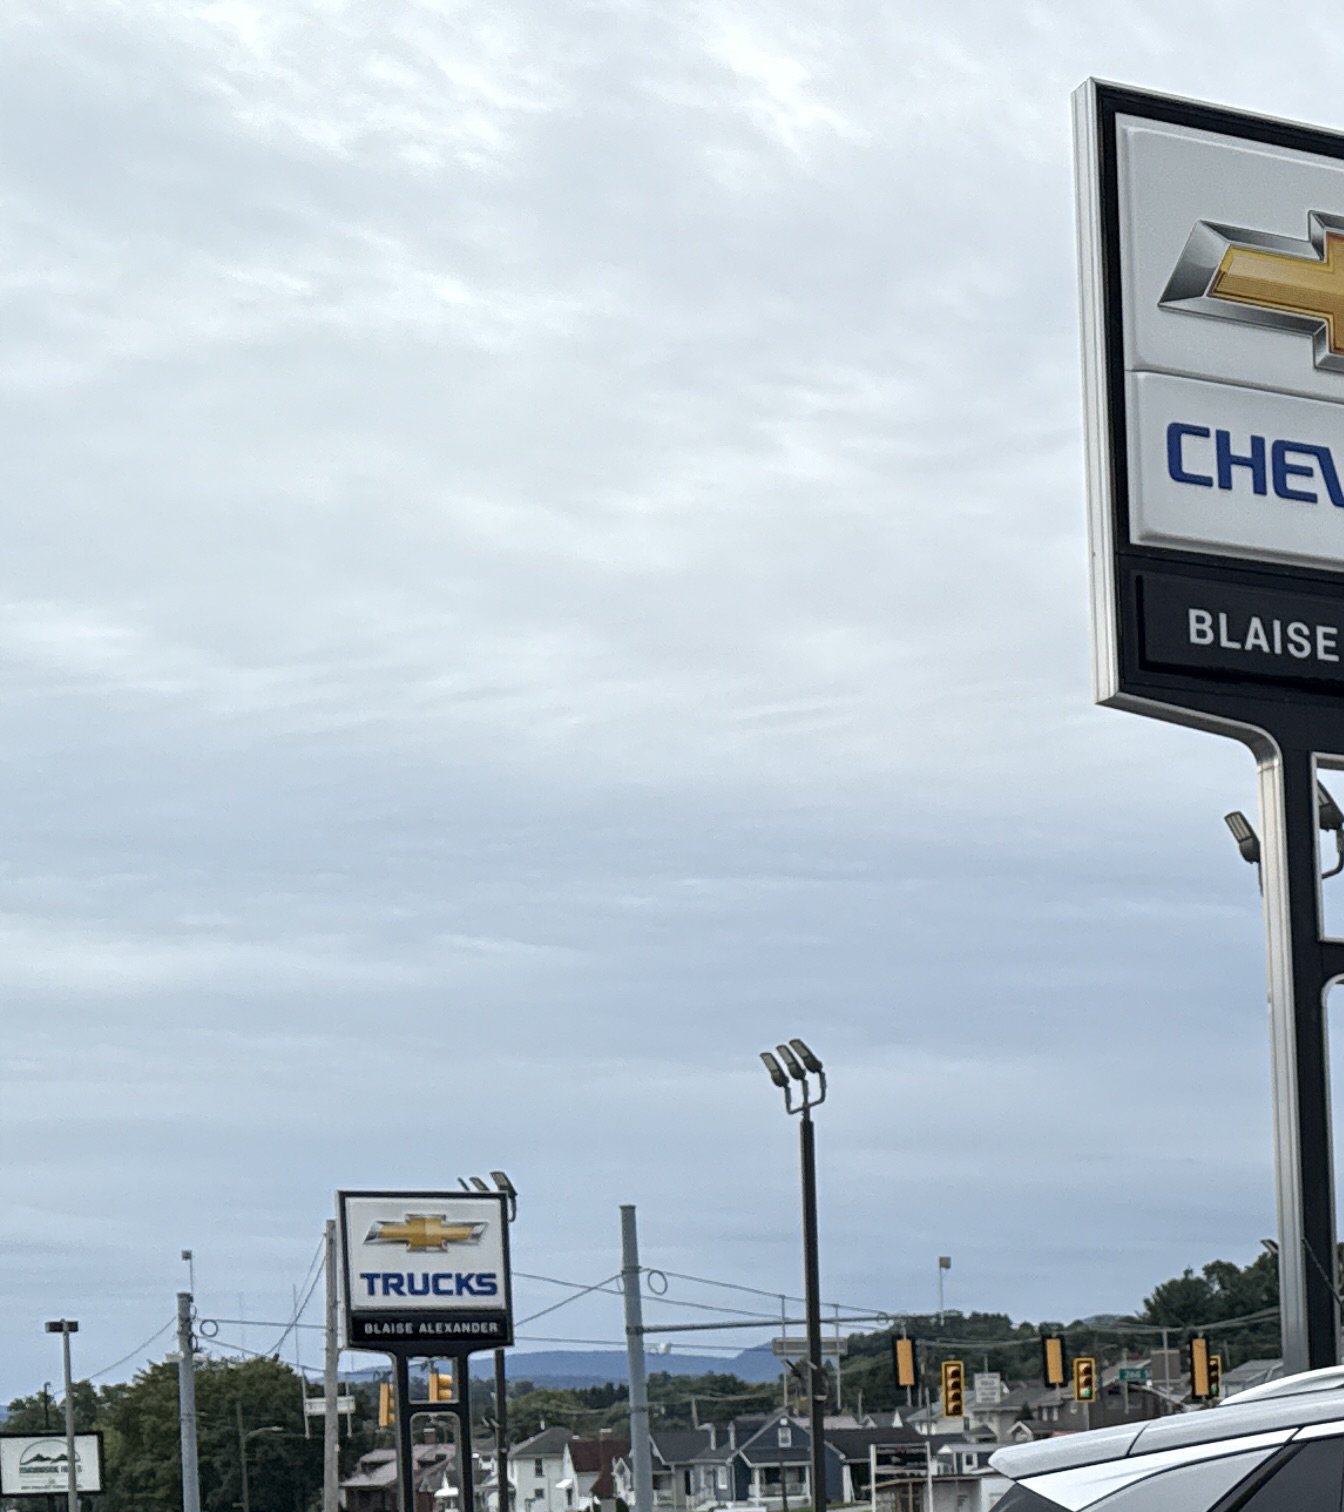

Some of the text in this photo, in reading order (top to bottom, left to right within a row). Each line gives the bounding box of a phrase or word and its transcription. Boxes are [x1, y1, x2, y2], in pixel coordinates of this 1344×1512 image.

[1187, 607, 1340, 663] BLAISE
[360, 1272, 498, 1296] TRUCKS
[364, 1321, 499, 1335] BLAISE ALEXANDER
